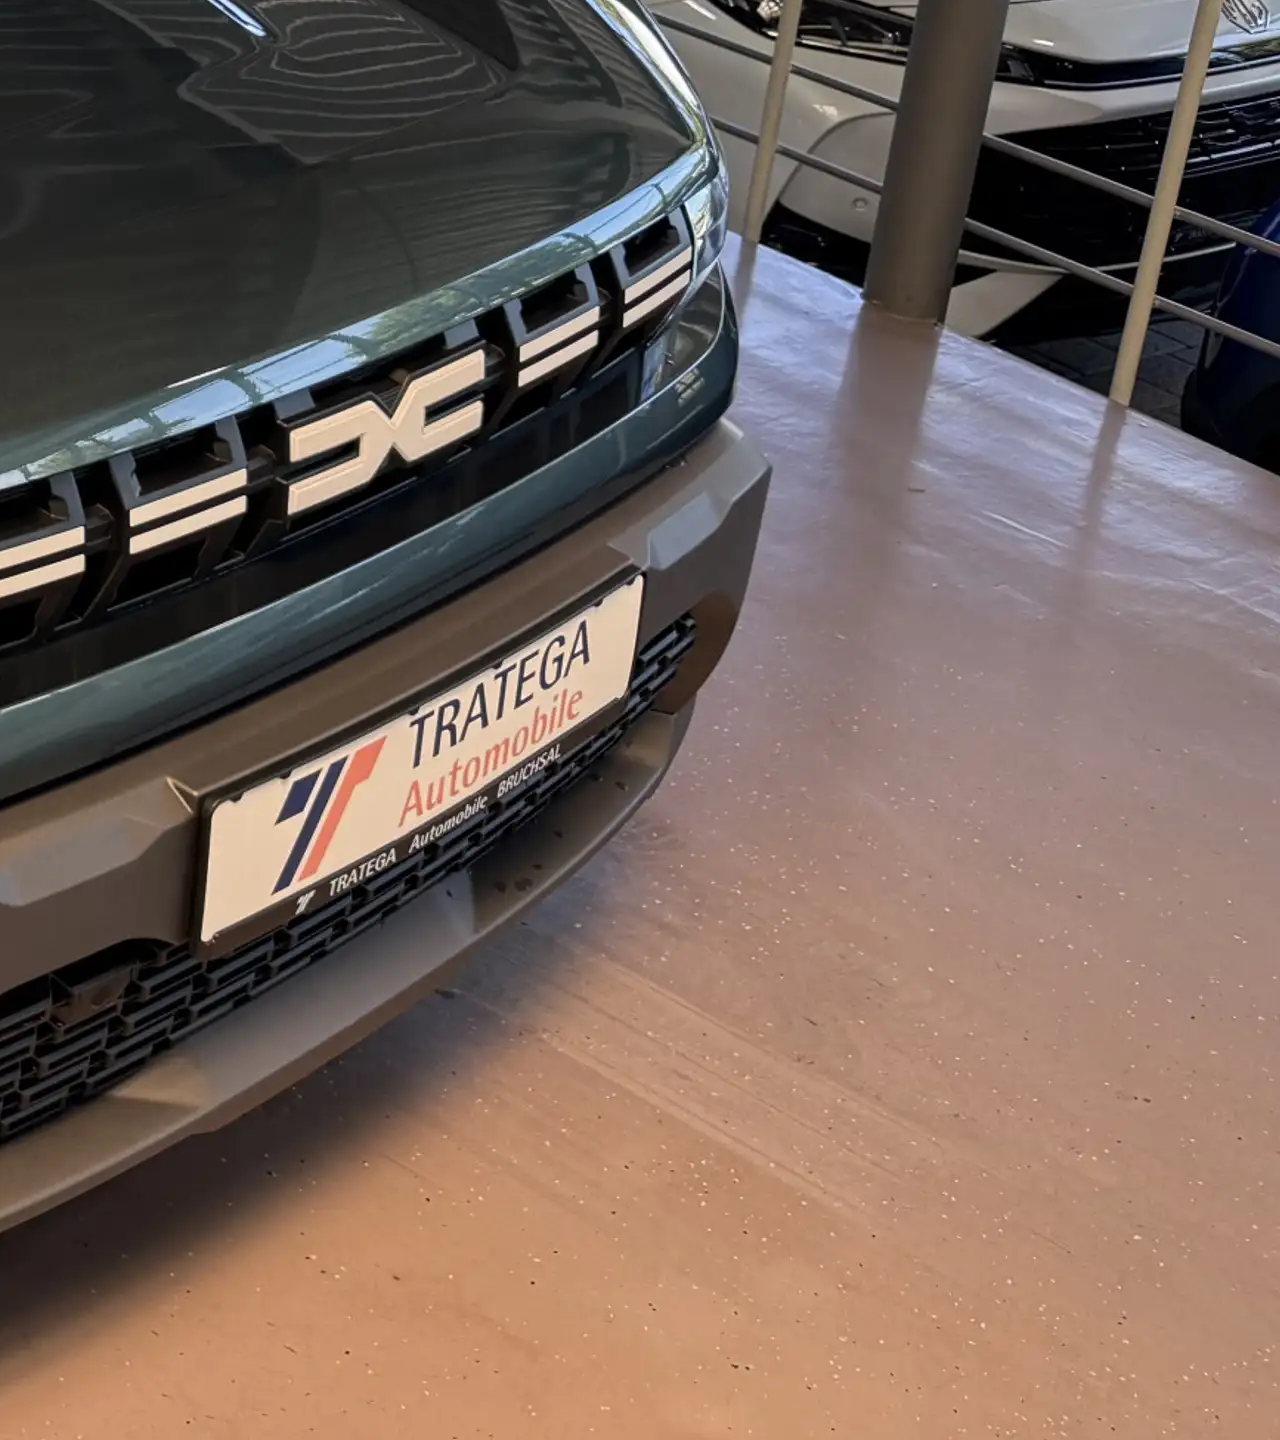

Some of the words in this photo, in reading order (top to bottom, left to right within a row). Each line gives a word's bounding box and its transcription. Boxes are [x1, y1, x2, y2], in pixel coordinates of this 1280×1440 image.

[398, 688, 583, 828] Automobile
[409, 619, 590, 769] TRATEGA
[329, 847, 397, 897] TRATEGA
[408, 794, 489, 854] Automobile
[496, 743, 561, 799] BRUCHSAL
